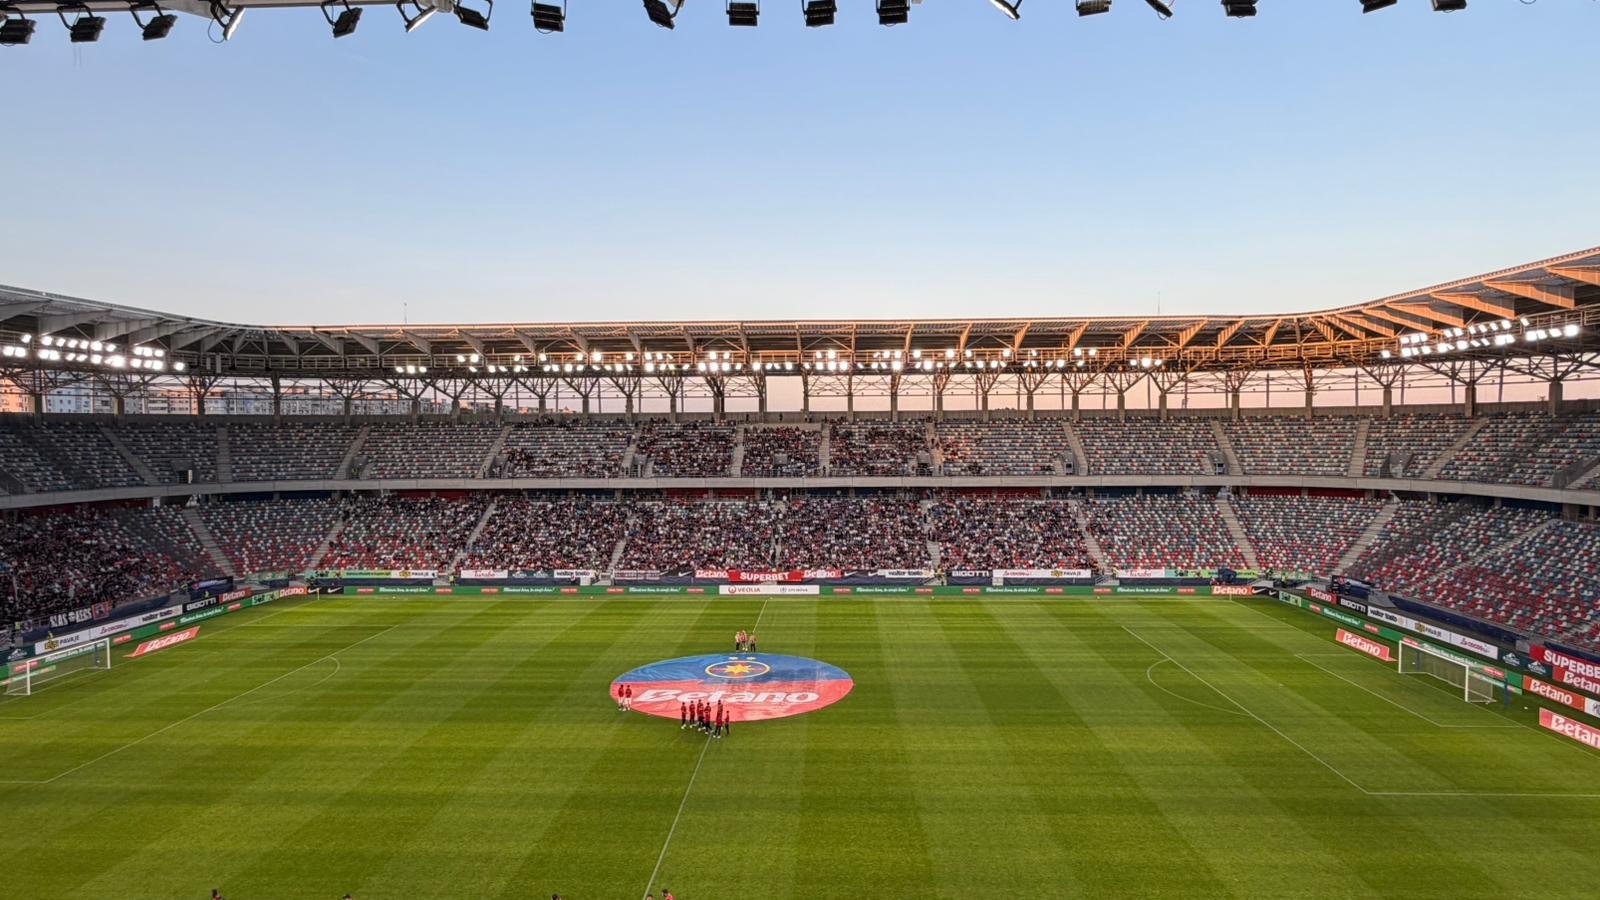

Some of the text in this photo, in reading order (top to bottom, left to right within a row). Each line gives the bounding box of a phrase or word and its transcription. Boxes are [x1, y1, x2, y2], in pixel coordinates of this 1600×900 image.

[696, 570, 728, 578] Betano
[740, 572, 790, 581] SUPERBET
[804, 570, 836, 578] Beno
[223, 590, 246, 601] Betano
[280, 587, 305, 595] Betano
[1213, 586, 1248, 595] Betano
[1310, 588, 1332, 602] Betano
[1342, 632, 1381, 656] Betano
[636, 689, 819, 703] Betano
[1530, 679, 1573, 705] Betano
